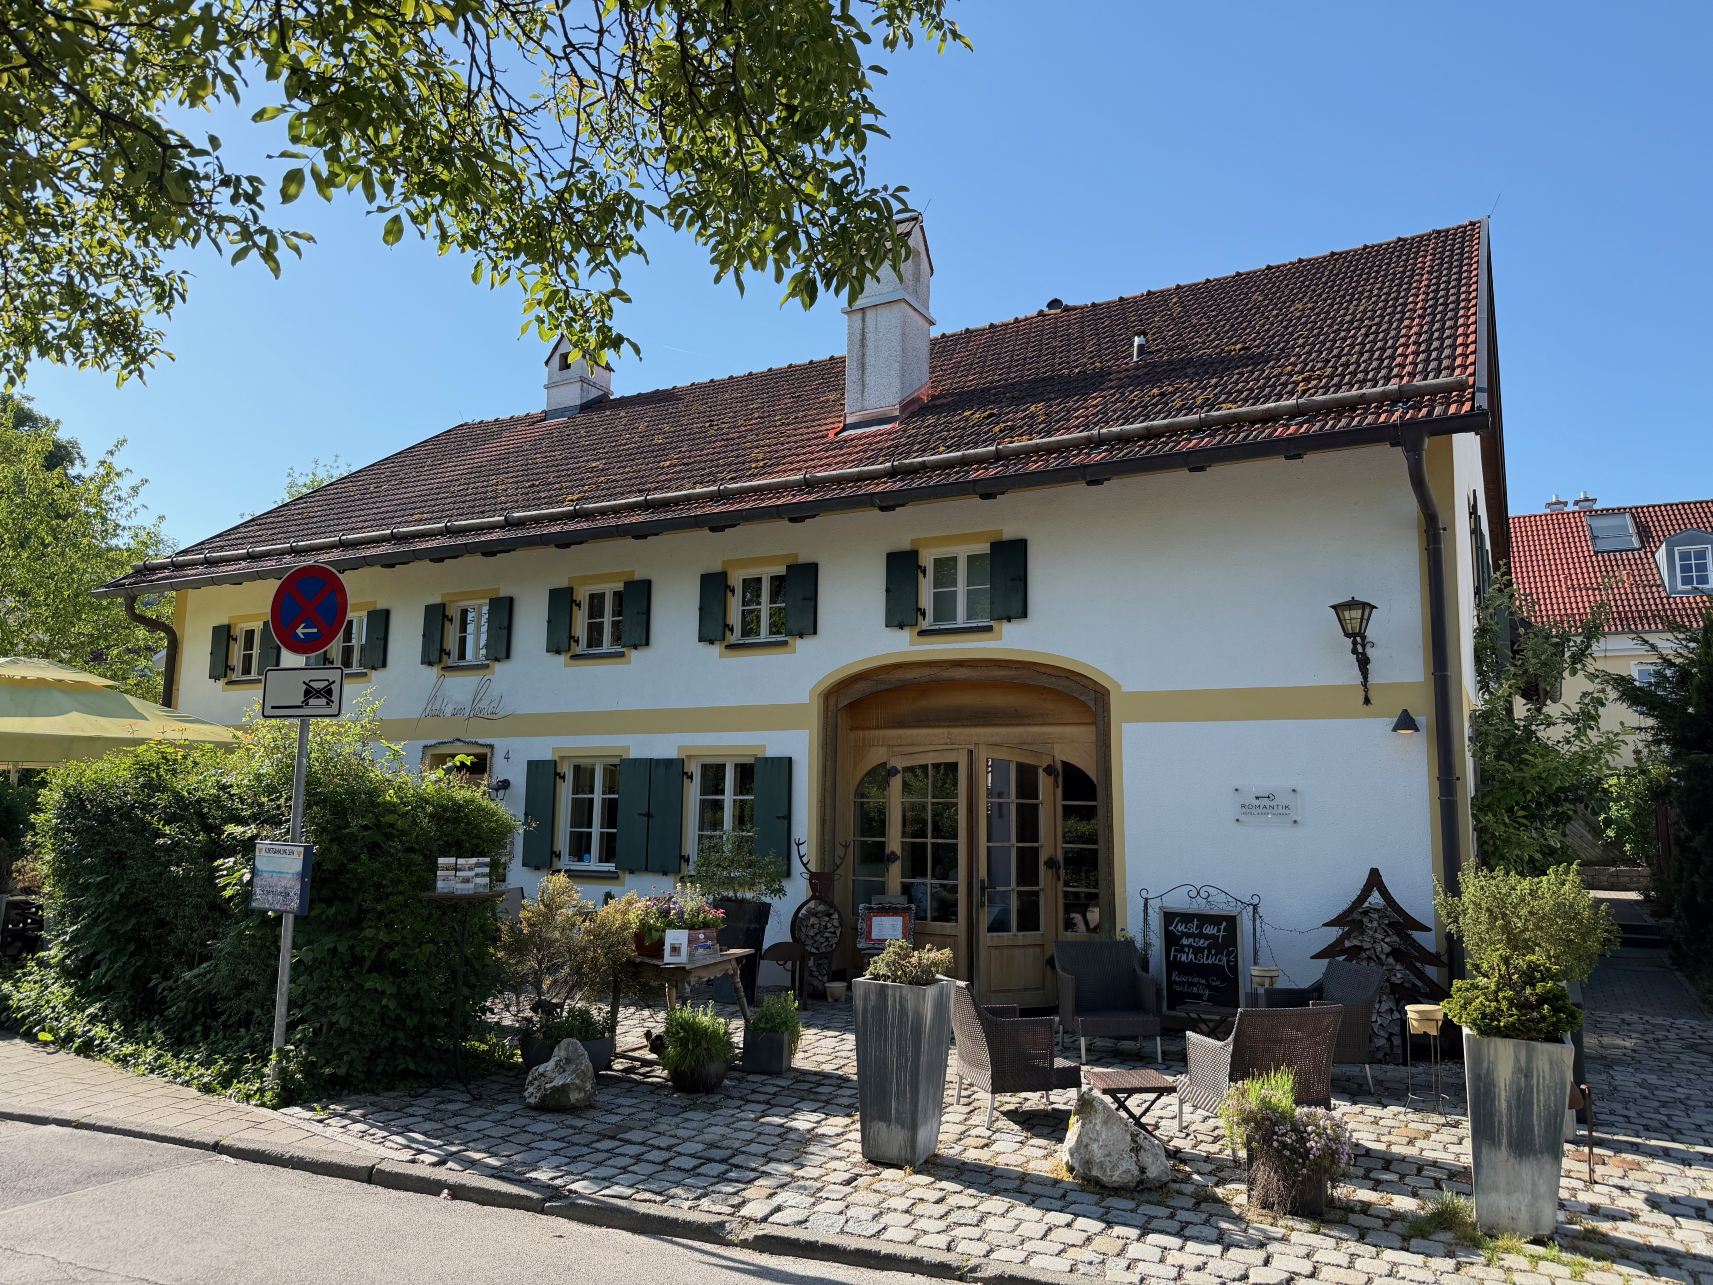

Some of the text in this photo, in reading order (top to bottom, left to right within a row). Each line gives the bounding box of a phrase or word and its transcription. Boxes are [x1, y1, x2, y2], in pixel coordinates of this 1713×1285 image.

[504, 748, 510, 762] 4
[1240, 803, 1291, 811] ROMANTIK
[1169, 917, 1228, 943] Lust auf
[1180, 936, 1213, 947] unser
